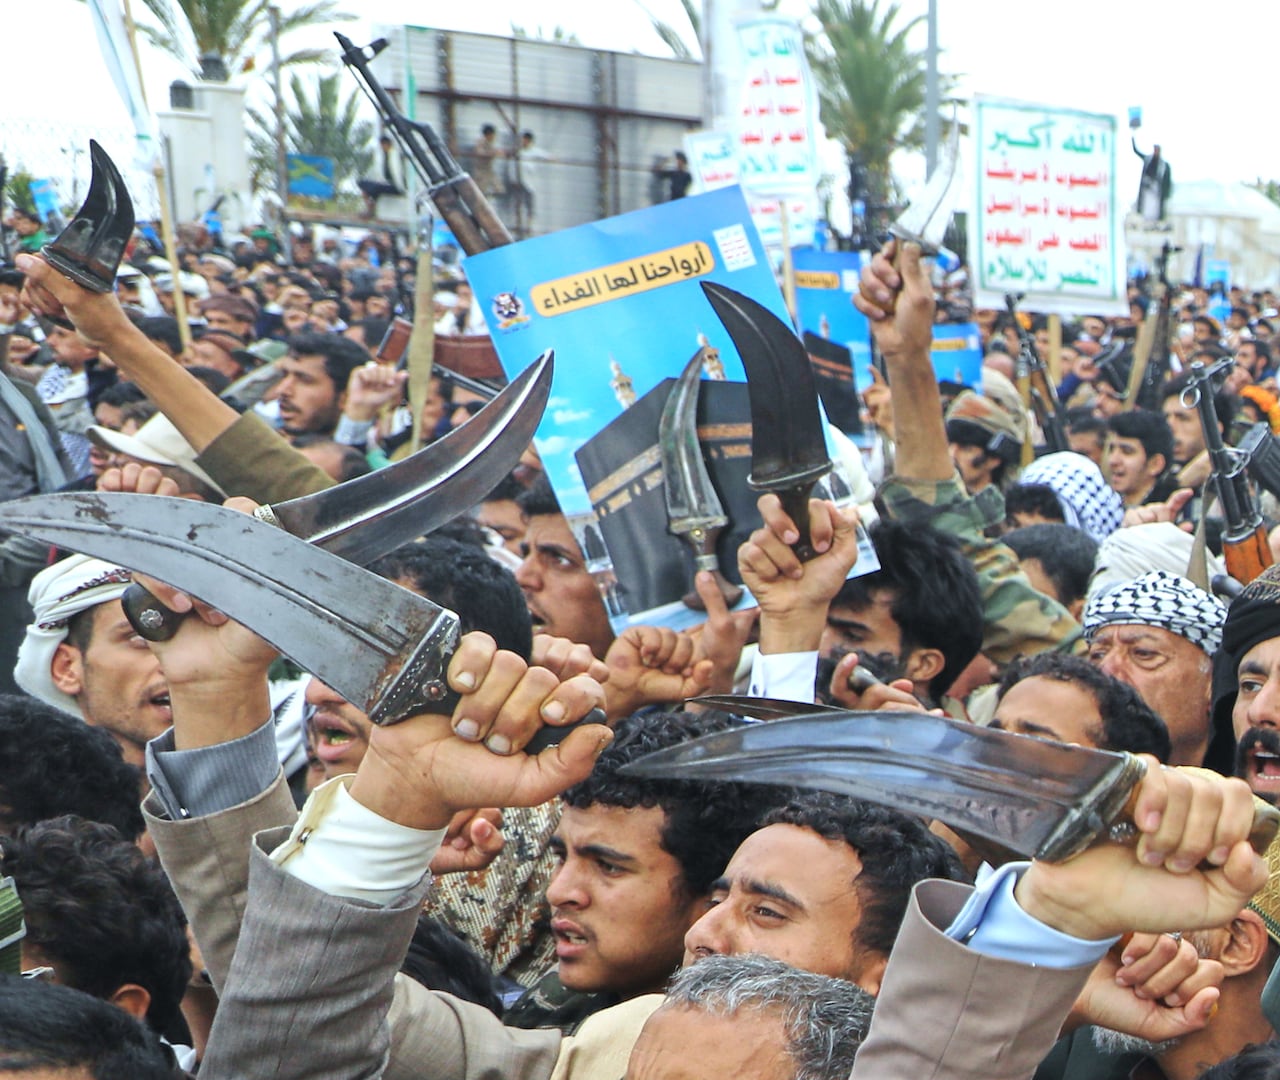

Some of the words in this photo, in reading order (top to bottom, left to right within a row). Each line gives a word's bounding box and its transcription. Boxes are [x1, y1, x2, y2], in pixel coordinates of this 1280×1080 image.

[604, 266, 638, 293] لها
[642, 245, 707, 282] أرواحنا
[543, 273, 601, 310] الفداء
